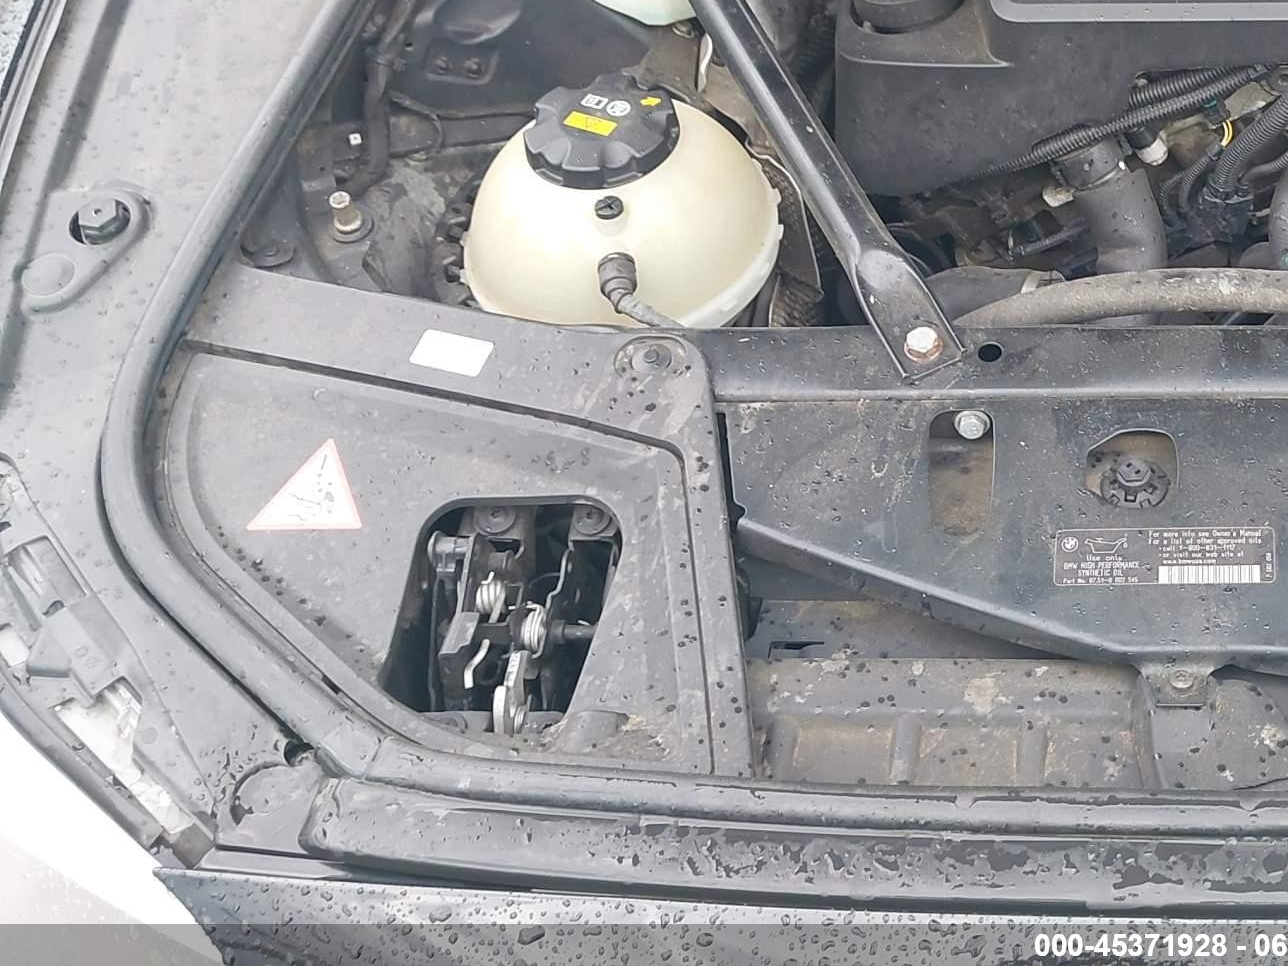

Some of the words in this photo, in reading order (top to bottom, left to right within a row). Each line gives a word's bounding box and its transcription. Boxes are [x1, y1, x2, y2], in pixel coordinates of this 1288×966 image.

[1212, 529, 1237, 537] Owner's
[1239, 529, 1262, 537] Manual
[1216, 537, 1246, 545] approved
[1086, 553, 1101, 562] Use
[1105, 553, 1123, 562] only
[1080, 561, 1096, 569] HIGH
[1097, 560, 1140, 570] PERFORMANCE
[1077, 569, 1111, 577] SYNTHETIC
[1113, 569, 1124, 577] OIL
